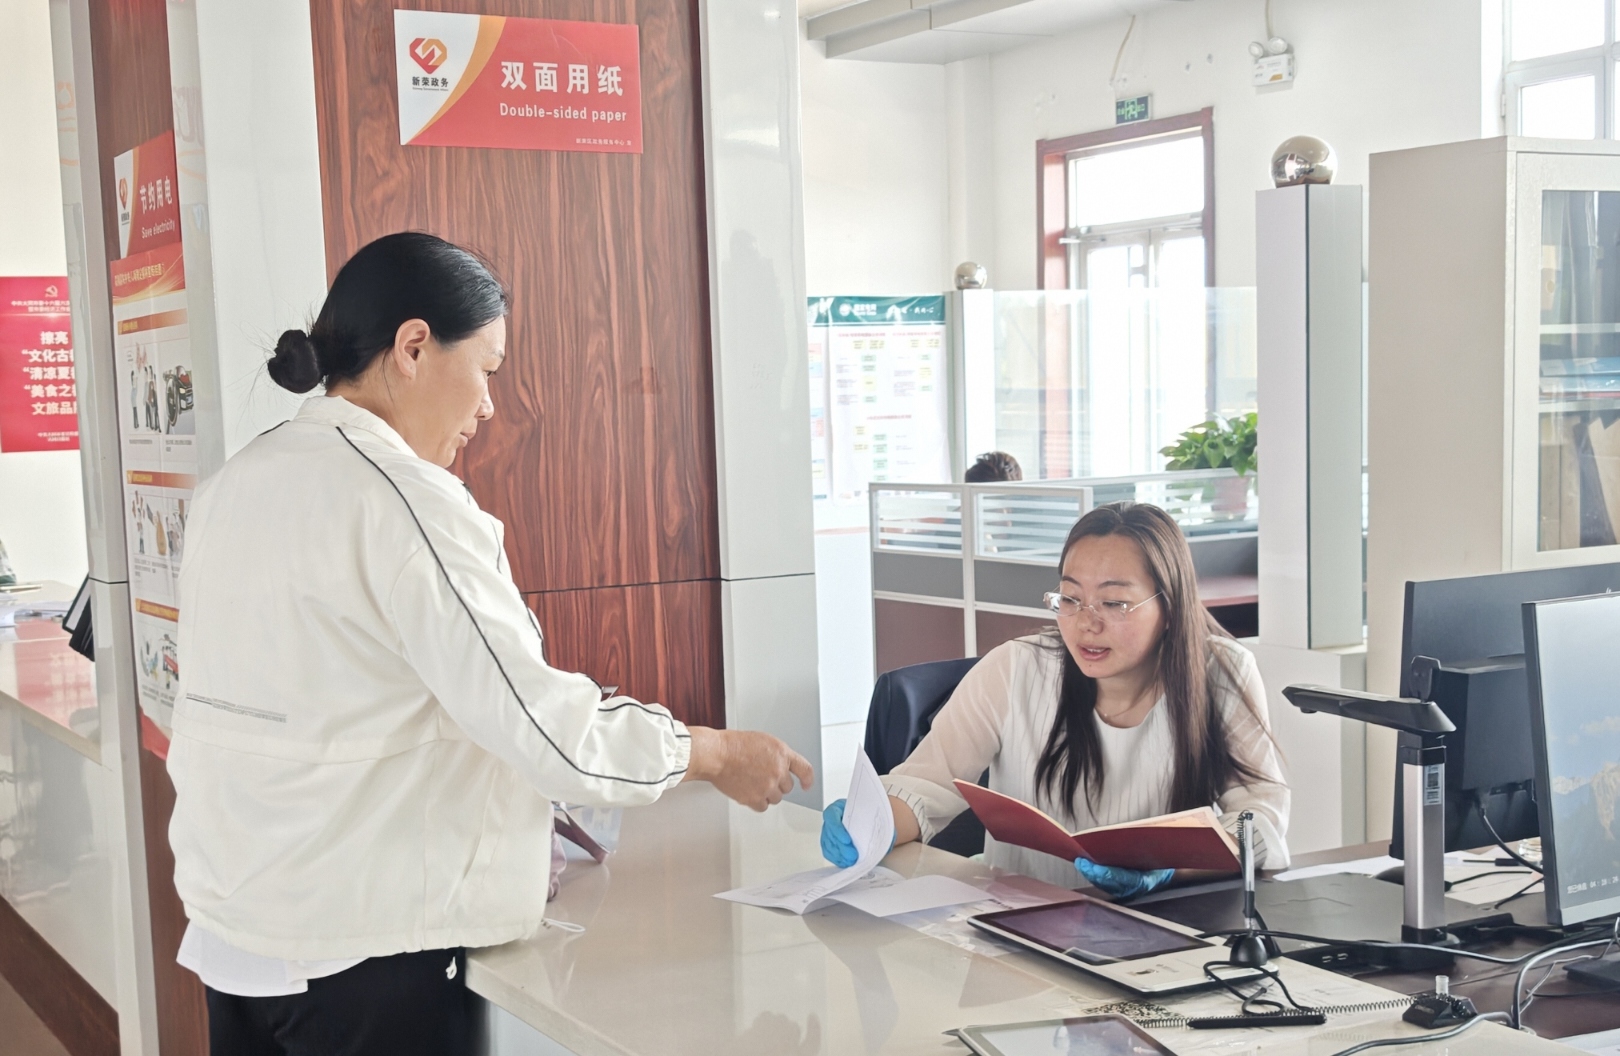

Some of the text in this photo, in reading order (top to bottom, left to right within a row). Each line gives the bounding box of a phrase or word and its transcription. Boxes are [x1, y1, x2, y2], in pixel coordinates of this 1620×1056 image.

[412, 76, 449, 88] 新荣政务
[501, 61, 623, 96] 双面用纸
[499, 102, 627, 123] Double-sided paper
[139, 175, 173, 215] 节约用电
[141, 218, 175, 239] Save electricity
[21, 348, 74, 362] “文化古
[23, 366, 75, 380] “清凉夏
